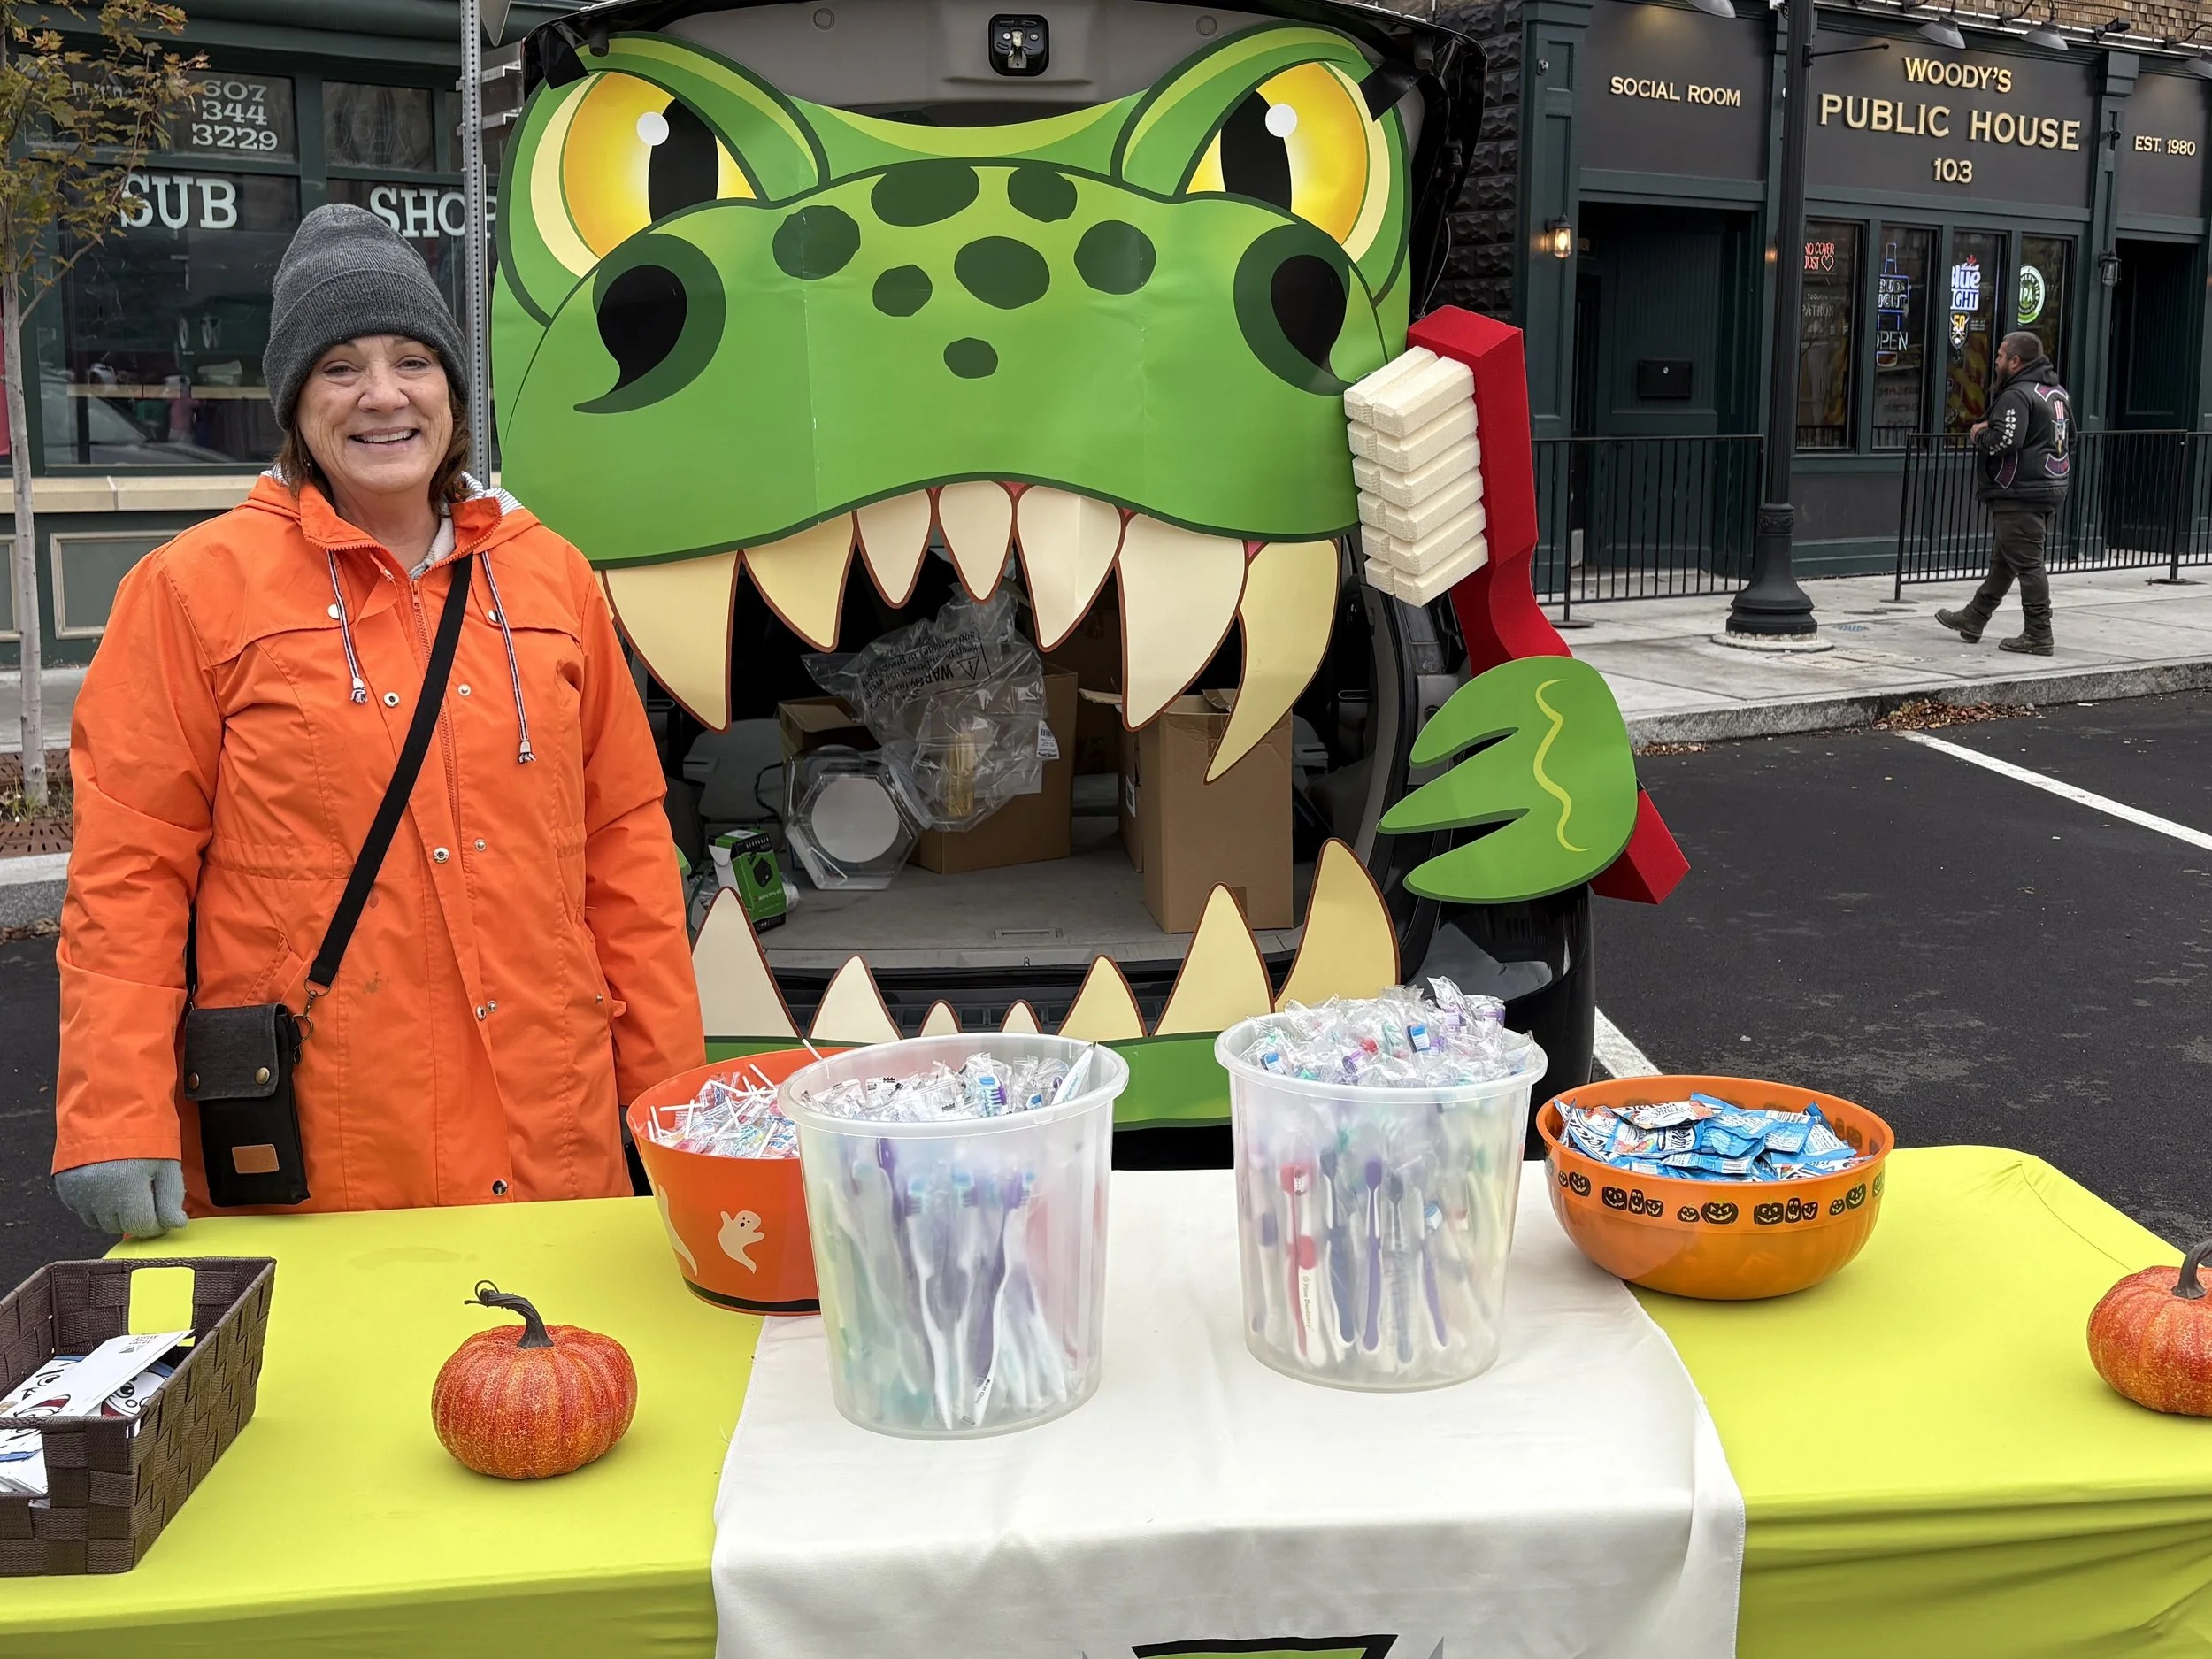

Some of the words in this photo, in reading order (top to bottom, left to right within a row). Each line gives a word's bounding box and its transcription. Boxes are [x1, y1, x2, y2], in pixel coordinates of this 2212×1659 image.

[1904, 57, 2012, 93] WOODY'S
[1610, 76, 1680, 101] SOCIAL
[1687, 84, 1740, 107] ROOM
[202, 99, 267, 126] 344
[1819, 92, 1950, 138] PUBLIC
[1969, 109, 2080, 151] HOUSE
[192, 122, 278, 151] 3229
[2135, 135, 2162, 153] EST.
[2167, 139, 2196, 156] 1980
[1933, 157, 1973, 184] 103
[120, 173, 238, 230] SUB
